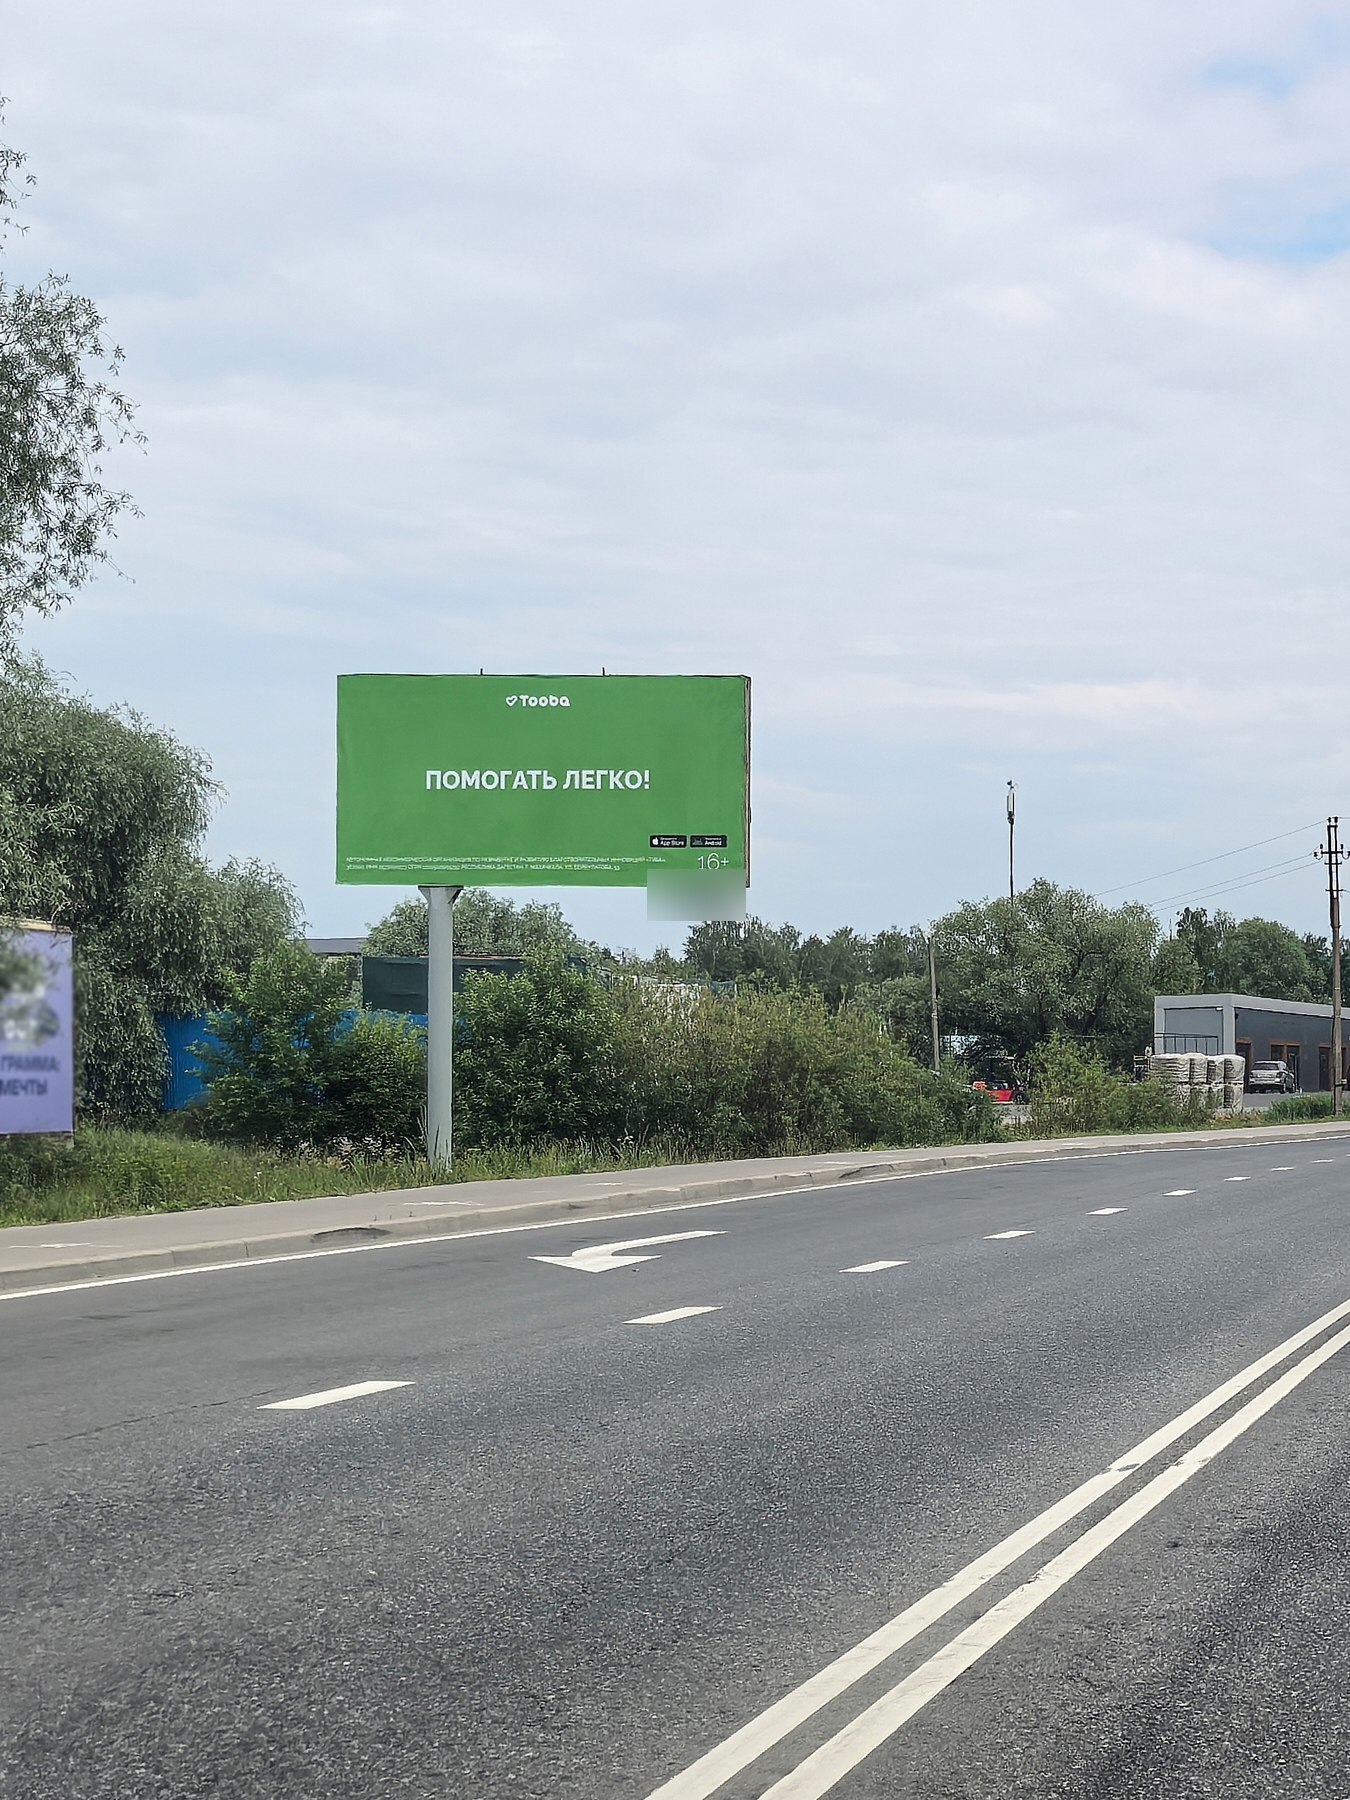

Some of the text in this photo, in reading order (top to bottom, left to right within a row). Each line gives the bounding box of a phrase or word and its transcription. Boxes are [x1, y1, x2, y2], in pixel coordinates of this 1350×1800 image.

[520, 694, 571, 707] Tooba
[426, 769, 651, 791] ПОМОГАТЬ ЛЕГКО!
[697, 852, 729, 869] 16+
